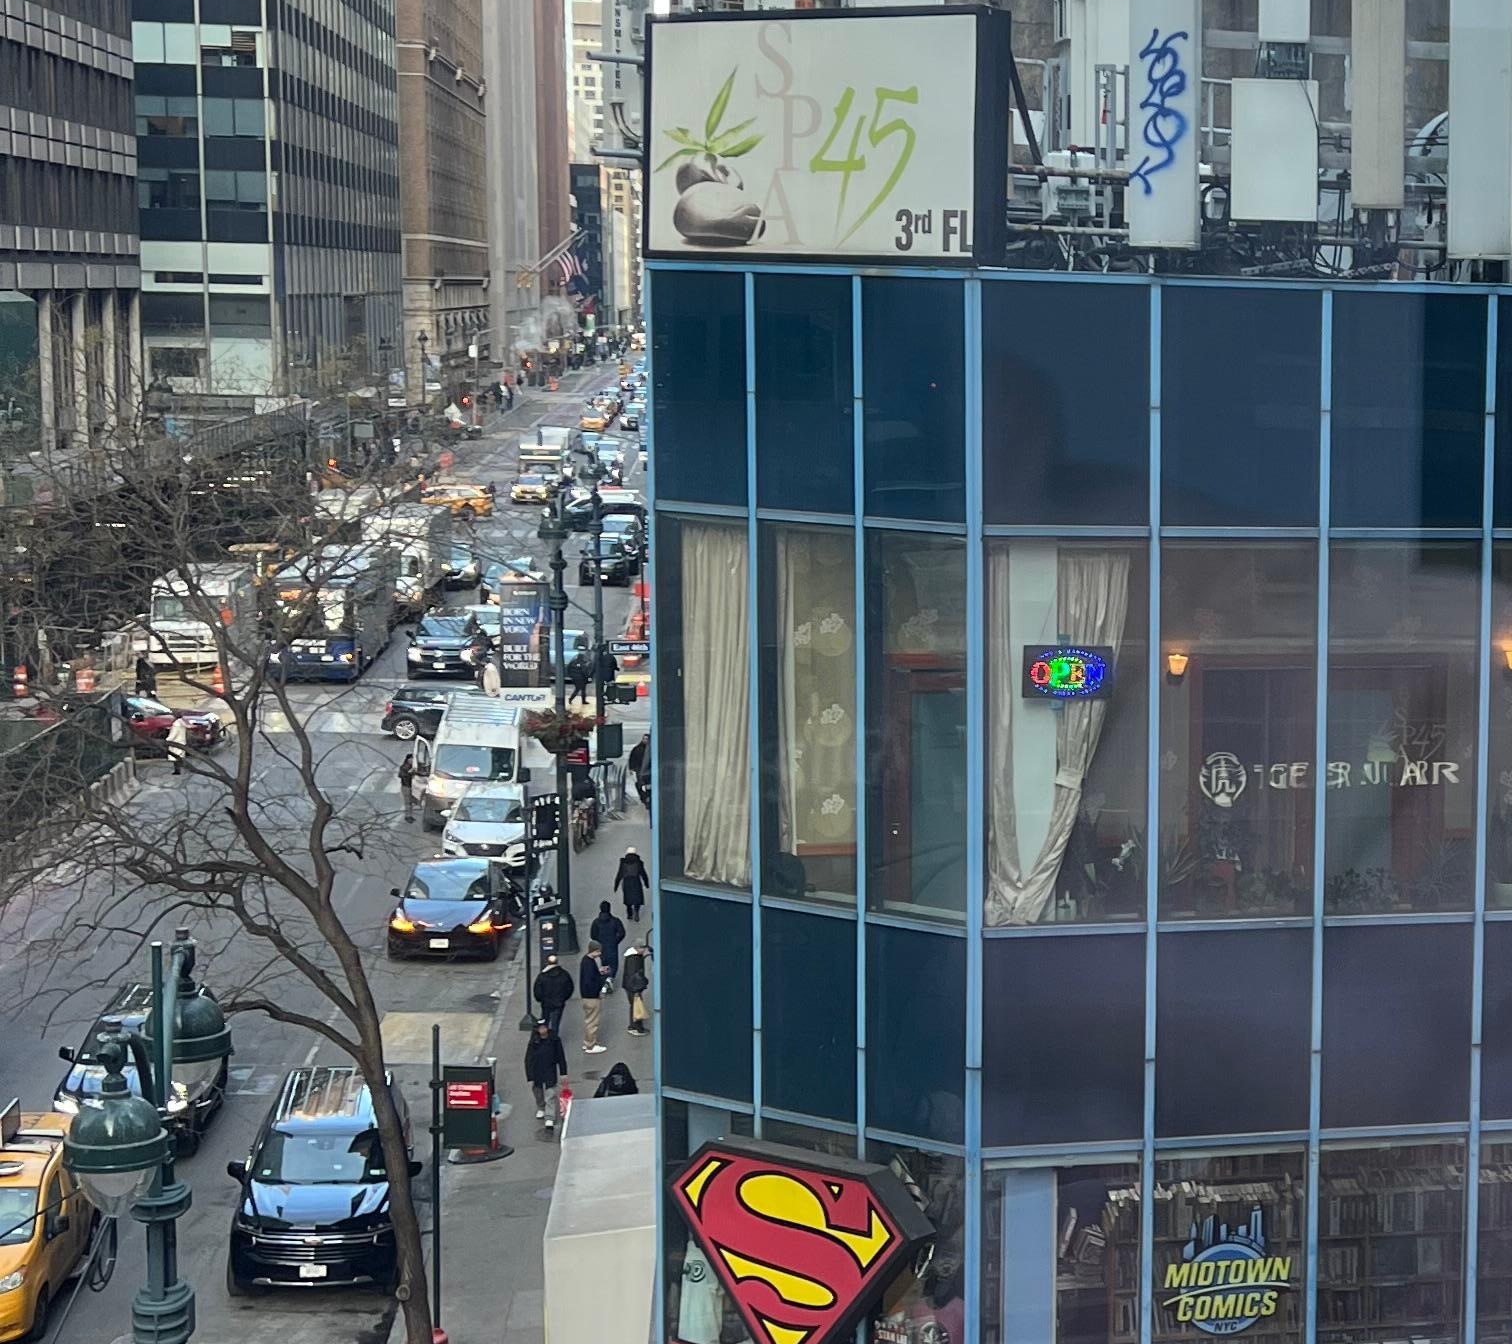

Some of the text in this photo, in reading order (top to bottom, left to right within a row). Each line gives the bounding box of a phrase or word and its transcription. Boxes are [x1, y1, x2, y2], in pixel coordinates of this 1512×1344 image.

[895, 209, 973, 253] 3rd FL
[1029, 661, 1105, 689] OPEN
[1163, 1256, 1292, 1289] MIDTOWN
[1176, 1290, 1279, 1322] COMICS
[1214, 1321, 1238, 1333] NYC
